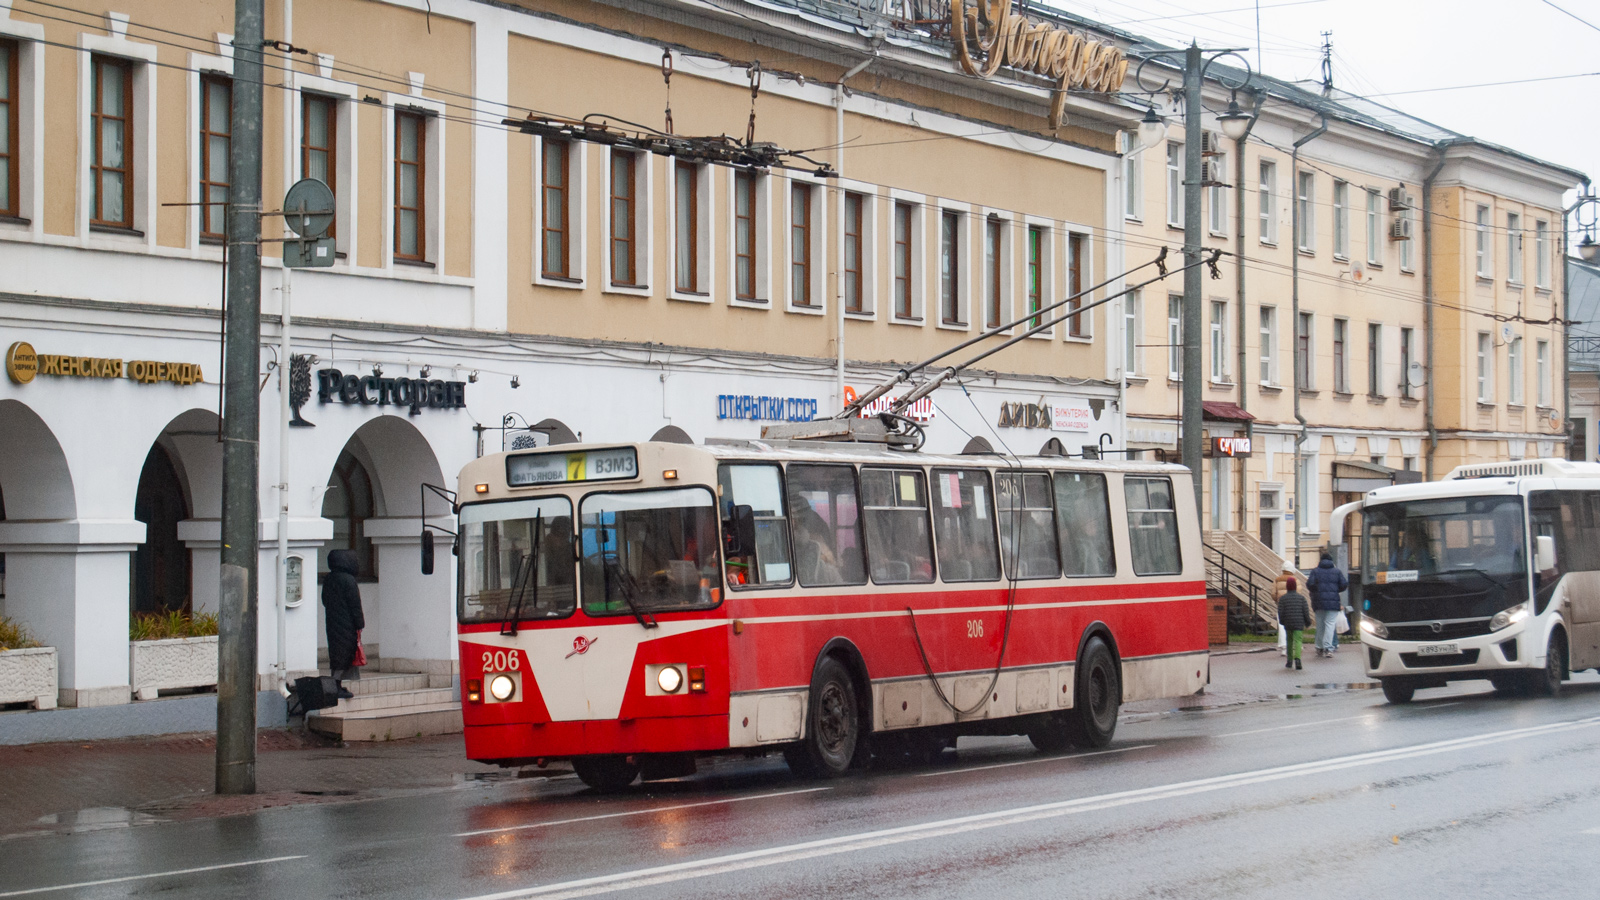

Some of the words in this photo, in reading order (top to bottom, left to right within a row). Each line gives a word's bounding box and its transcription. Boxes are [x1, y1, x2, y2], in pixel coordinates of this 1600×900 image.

[42, 354, 123, 378] ЖЕНСКАЯ
[130, 360, 204, 385] ОДЕЖДА
[317, 368, 466, 415] Ресторан
[718, 394, 784, 421] ОТКРЫТКИ
[787, 397, 817, 421] СССР
[899, 397, 937, 421] ИЦЦА
[998, 401, 1052, 429] ДИВА
[1055, 408, 1088, 418] БИЖУТЕРИЯ
[513, 470, 563, 482] ФАТЬЯНОВА
[569, 457, 582, 479] 7
[595, 456, 634, 474] ВЭМЗ
[1000, 478, 1019, 497] 206
[967, 619, 984, 638] 206
[482, 650, 520, 672] 206
